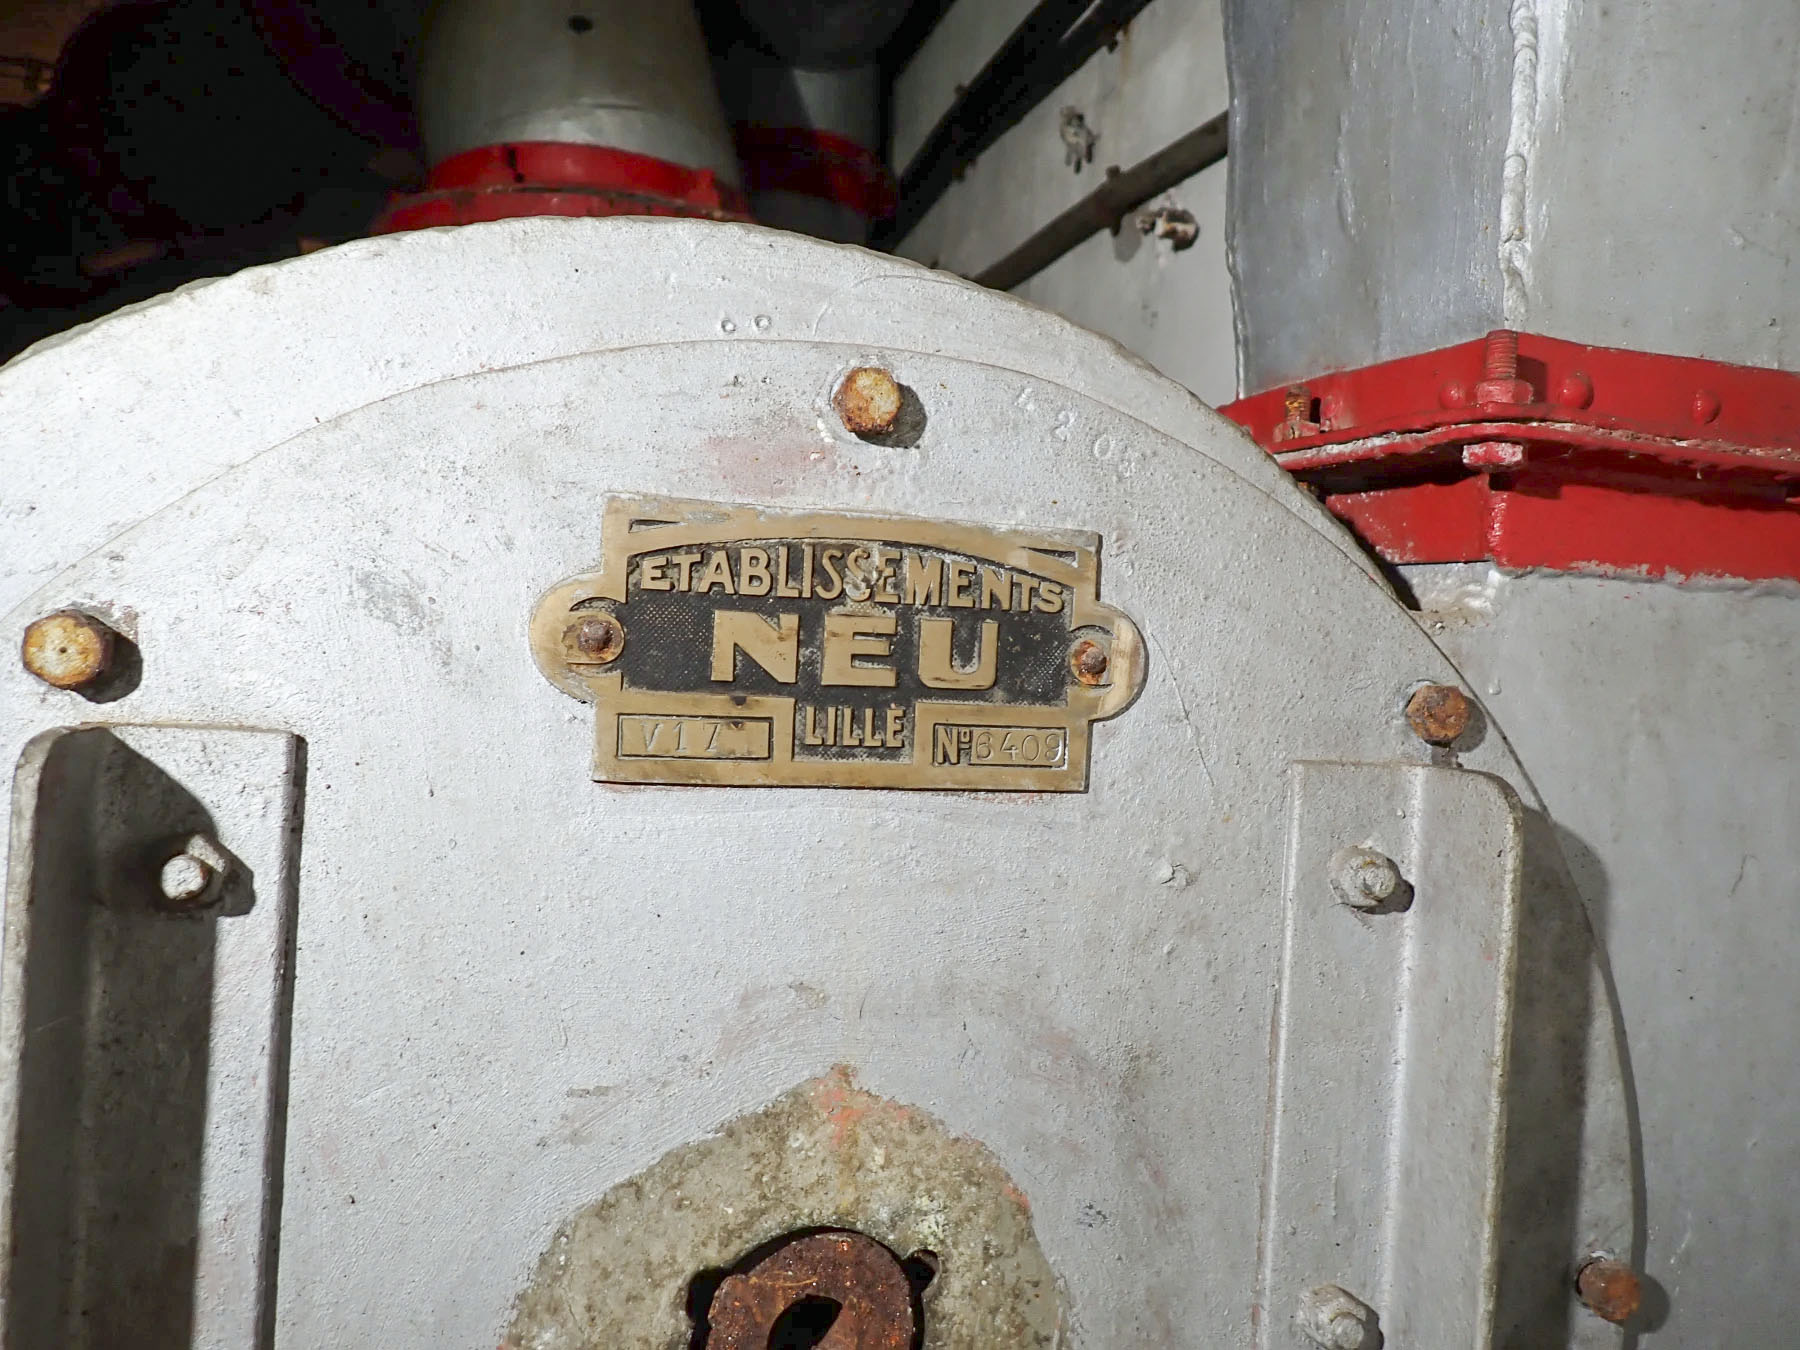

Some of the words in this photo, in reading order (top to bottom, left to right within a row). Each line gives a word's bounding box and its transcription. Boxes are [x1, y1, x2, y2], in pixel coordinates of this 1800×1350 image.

[641, 544, 1067, 613] ETABLISSEMENTS
[710, 609, 999, 689] NEU
[805, 706, 907, 747] LILLE
[975, 731, 1063, 763] 6409
